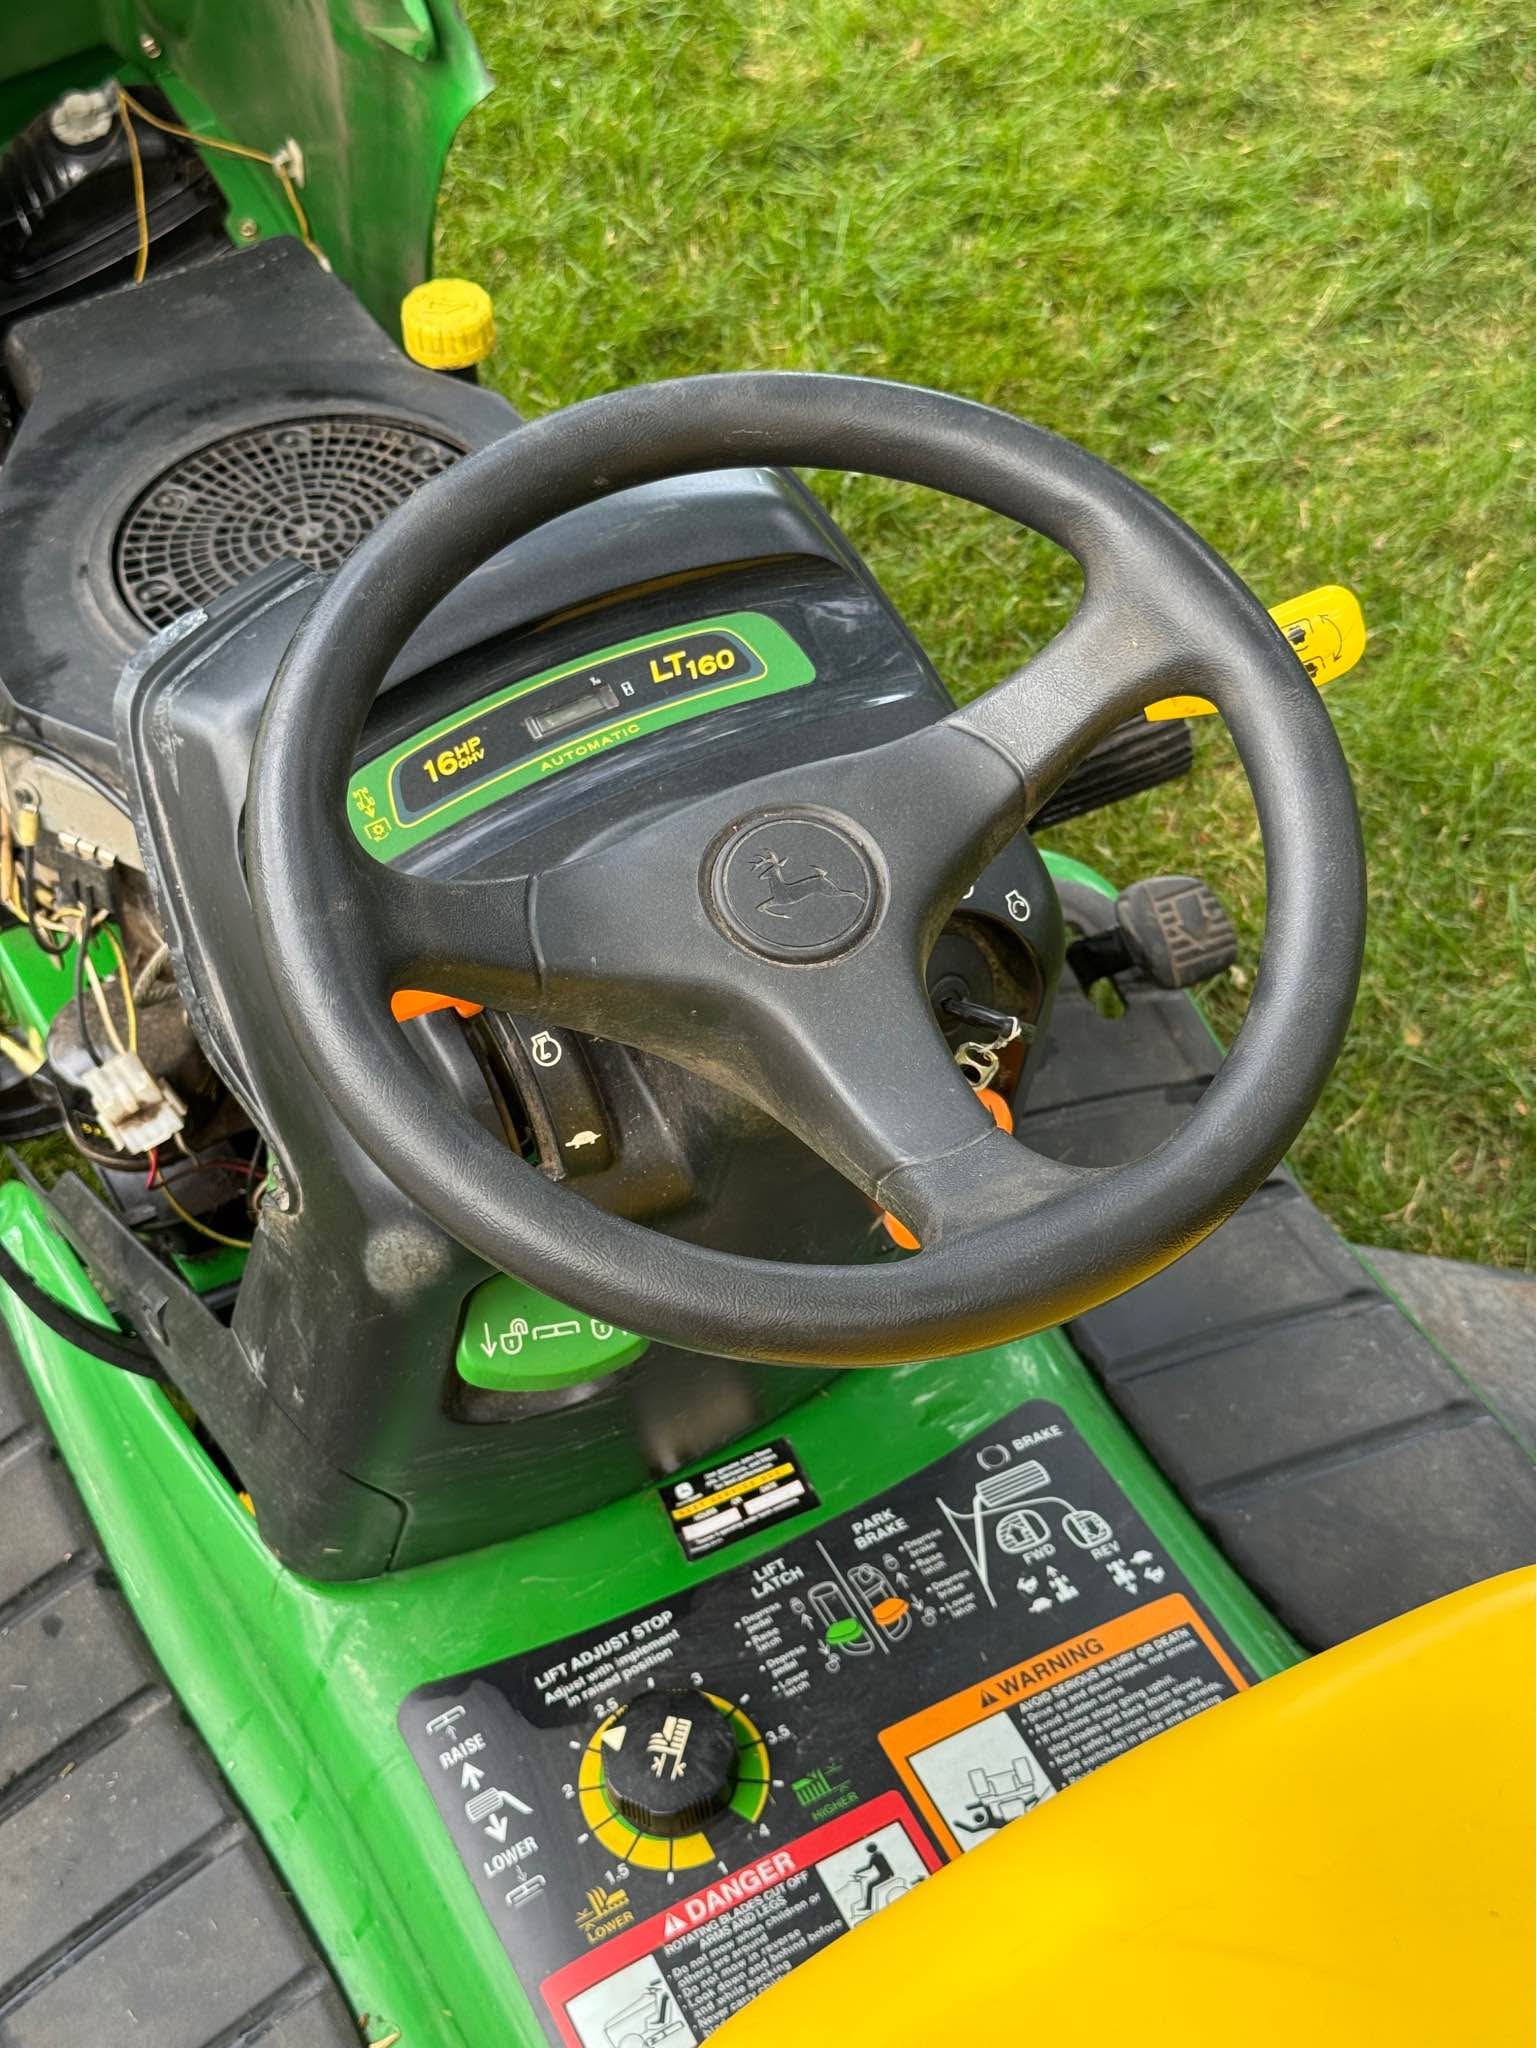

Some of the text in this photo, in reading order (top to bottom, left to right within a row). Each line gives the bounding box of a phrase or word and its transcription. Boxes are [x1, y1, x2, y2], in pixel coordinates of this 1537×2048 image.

[650, 649, 735, 683] LT160
[458, 747, 485, 770] OHV
[540, 723, 641, 772] AUTOMATIC
[423, 750, 459, 783] 16
[1012, 1424, 1063, 1451] BRAKE
[851, 1508, 896, 1535] PARK
[854, 1518, 908, 1550] BRAKE
[1022, 1543, 1056, 1565] FWD
[1090, 1540, 1120, 1561] REV
[751, 1566, 804, 1599] LATCH
[753, 1558, 786, 1582] LIFT
[534, 1610, 673, 1690] LIFT ADJUST STOP
[545, 1629, 680, 1705] Adjust with implement
[565, 1648, 673, 1707] in raised position
[690, 1671, 704, 1686] 3
[996, 1638, 1104, 1696] WARNING
[1019, 1691, 1052, 1713] AVOID
[1051, 1668, 1099, 1696] SERIOUS
[1136, 1643, 1156, 1658] OR
[1153, 1628, 1190, 1650] DEATH
[593, 1697, 619, 1718] 2.5
[765, 1723, 791, 1745] 3.5
[439, 1732, 487, 1770] RAISE
[561, 1783, 576, 1800] 2
[812, 1792, 858, 1821] HIGHER
[758, 1822, 771, 1838] 4
[483, 1836, 539, 1879] LOWER
[605, 1863, 630, 1885] 1.5
[717, 1860, 729, 1875] 1
[684, 1852, 795, 1924] DANGER
[587, 1911, 634, 1944] LOWER
[662, 1870, 808, 1955] ROTATING BLADES CUT OFF
[700, 1895, 787, 1950] ARMS AND LEGS
[672, 1892, 821, 1980] Do not mow when children or
[676, 1932, 769, 1989] others are around
[681, 1929, 804, 1998] Do not mow in reverse
[686, 1919, 842, 2008] Look down and behind before
[692, 1960, 794, 2020] and while backing
